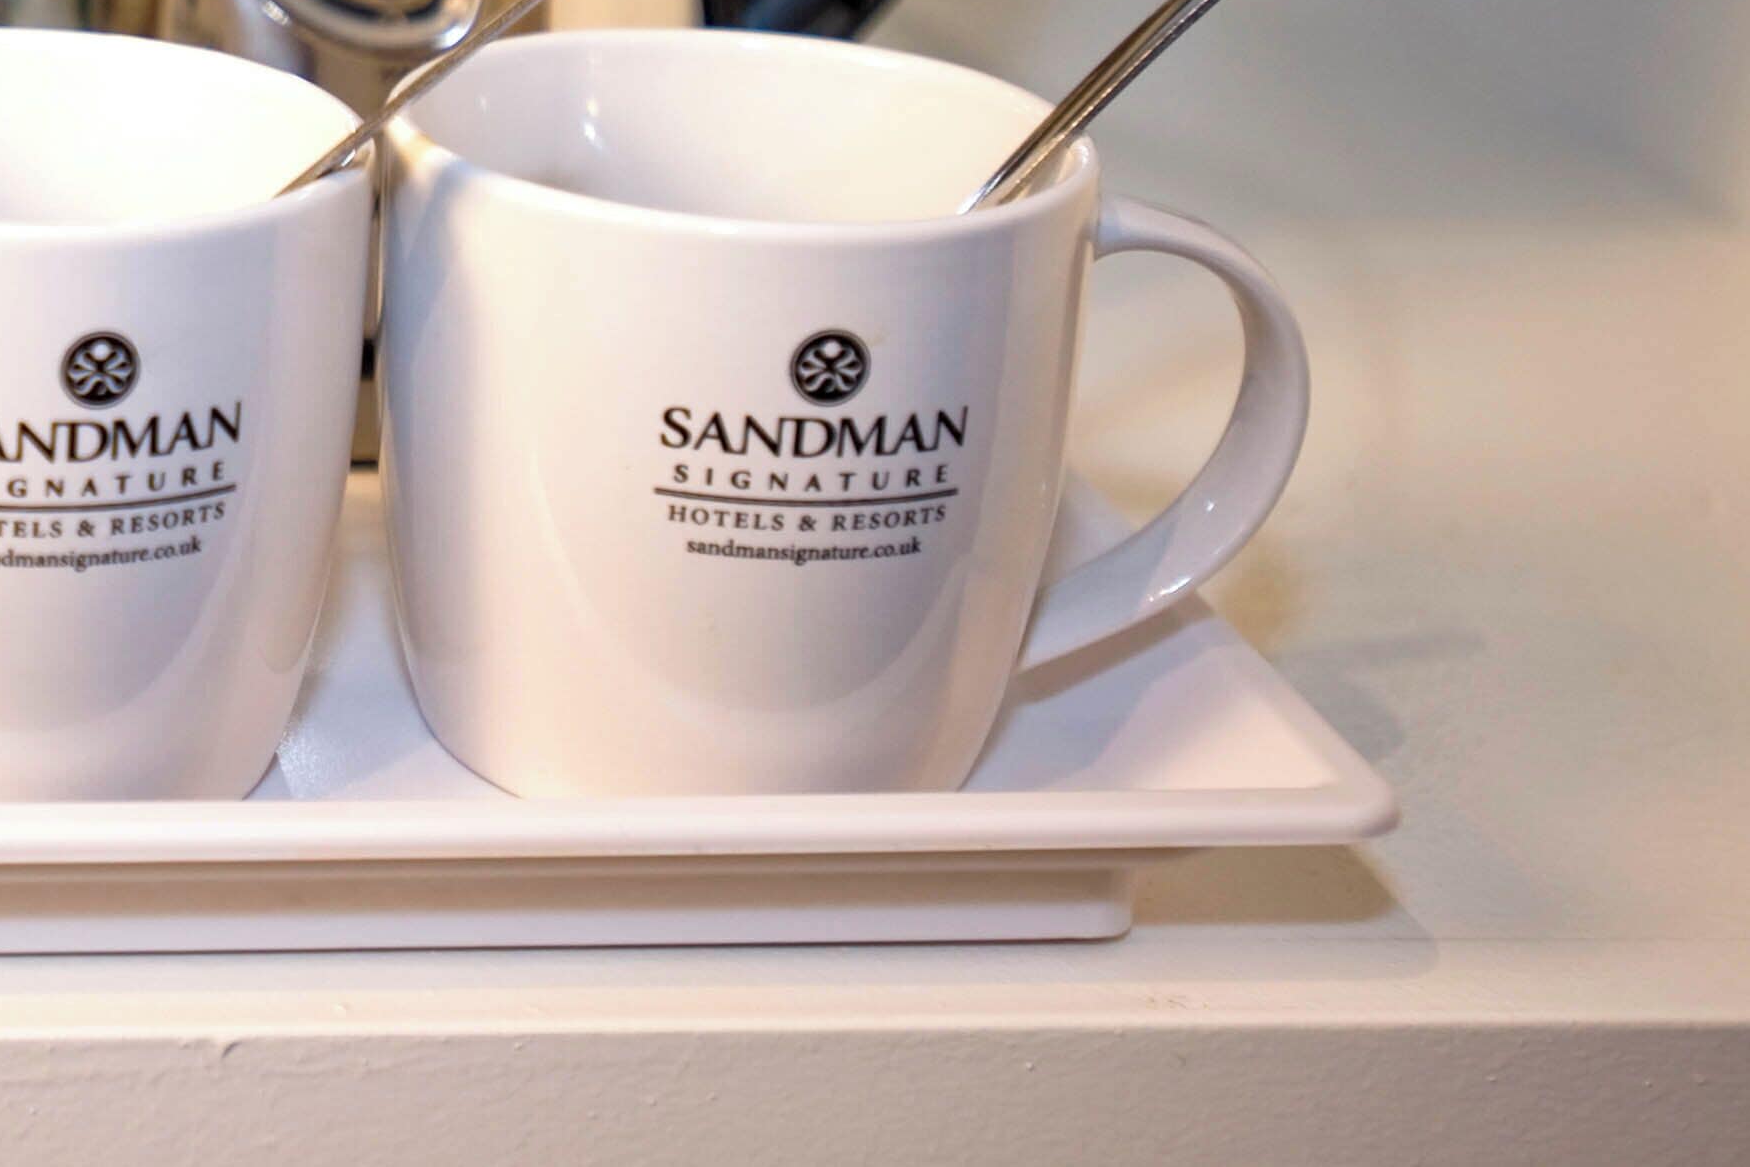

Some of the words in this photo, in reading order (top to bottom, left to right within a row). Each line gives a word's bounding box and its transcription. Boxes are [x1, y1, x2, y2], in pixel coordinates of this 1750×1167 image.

[660, 405, 969, 458] SANDMAN
[673, 463, 950, 493] SIGNATURE
[76, 519, 96, 538] &
[109, 501, 226, 537] RESORTS
[667, 504, 785, 532] HOTELS
[797, 513, 817, 532] &
[830, 505, 947, 532] RESORTS
[686, 537, 922, 566] sandmansignature.co.uk
